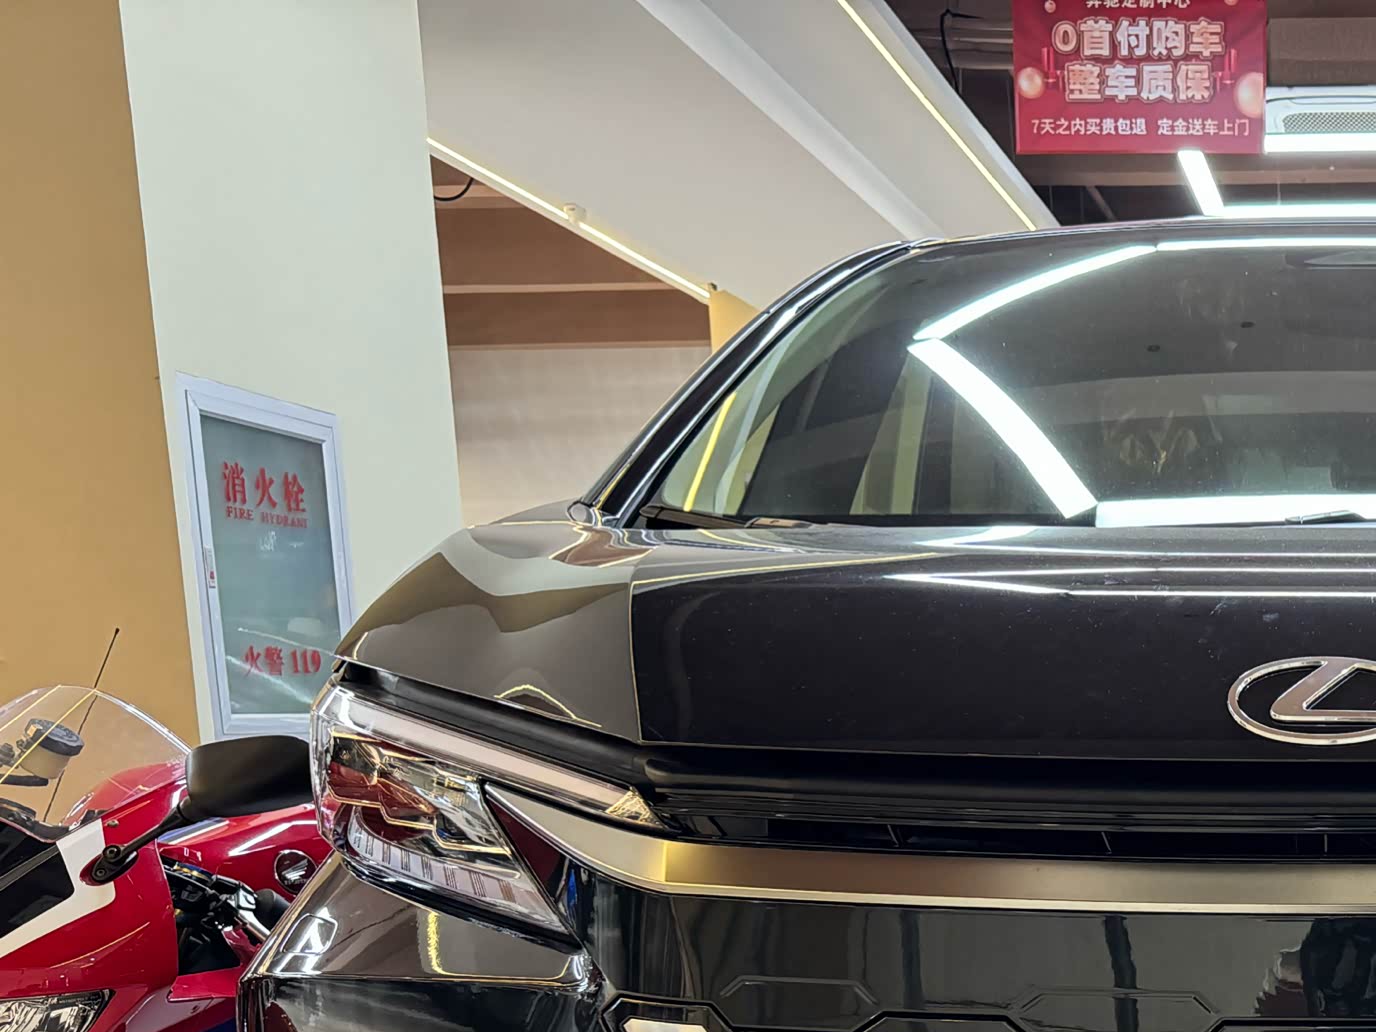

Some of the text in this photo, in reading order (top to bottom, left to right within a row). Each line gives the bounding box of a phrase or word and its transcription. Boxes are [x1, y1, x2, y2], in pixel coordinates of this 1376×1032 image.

[1053, 17, 1224, 58] 0首付购车
[1066, 61, 1213, 102] 整车质保
[1031, 118, 1249, 136] 7天之内买贵包退 定金送车上门
[223, 461, 306, 512] 消火栓
[226, 506, 254, 521] FIRE
[244, 645, 322, 676] 火警 119
